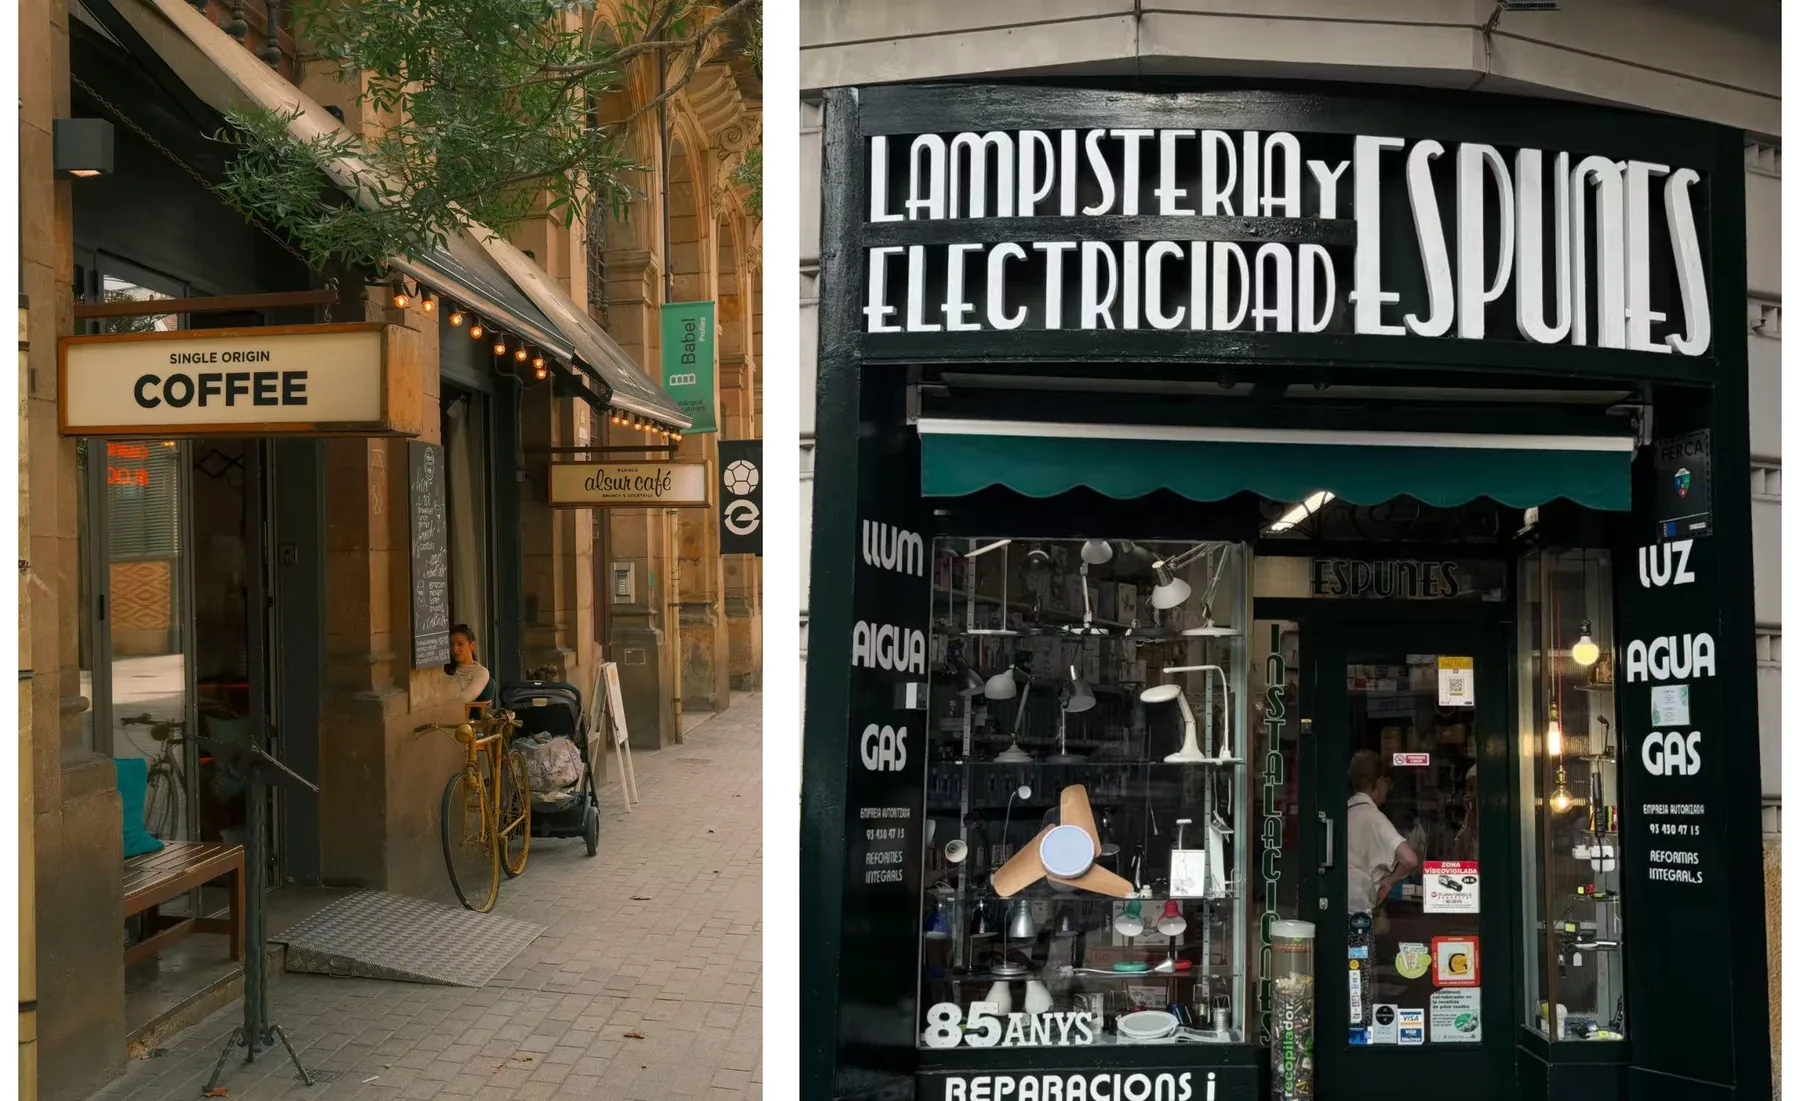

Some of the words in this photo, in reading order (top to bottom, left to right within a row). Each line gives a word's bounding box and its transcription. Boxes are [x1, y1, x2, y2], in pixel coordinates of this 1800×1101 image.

[869, 128, 1301, 222] LAMPISTERIA
[863, 240, 1336, 334] ELECTRICIDAD
[169, 352, 218, 365] SINGLE
[221, 350, 270, 363] ORIGIN
[681, 317, 696, 365] Babel
[133, 370, 308, 409] COFFEE
[1660, 440, 1704, 460] FERCA
[584, 468, 631, 492] alsur
[634, 467, 672, 498] café
[862, 519, 924, 577] LLUM
[1638, 539, 1695, 588] LUZ
[851, 620, 926, 675] AIGUA
[1626, 632, 1716, 683] AGUA
[860, 723, 908, 772] GAS
[1641, 731, 1701, 776] GAS
[1643, 804, 1668, 815] EMPRESA
[1669, 804, 1705, 815] AUTORIZADA
[888, 828, 896, 839] 47
[1649, 823, 1660, 835] 93
[1661, 823, 1677, 836] 430
[1678, 824, 1688, 836] 47
[1690, 825, 1700, 836] 15
[865, 850, 903, 865] REFORMES
[865, 869, 903, 884] INTEGRALS
[1650, 850, 1699, 865] REFORMAS
[924, 1001, 1001, 1048] 85
[1001, 1012, 1094, 1046] ANYS
[945, 1072, 1192, 1101] REPARACIONS
